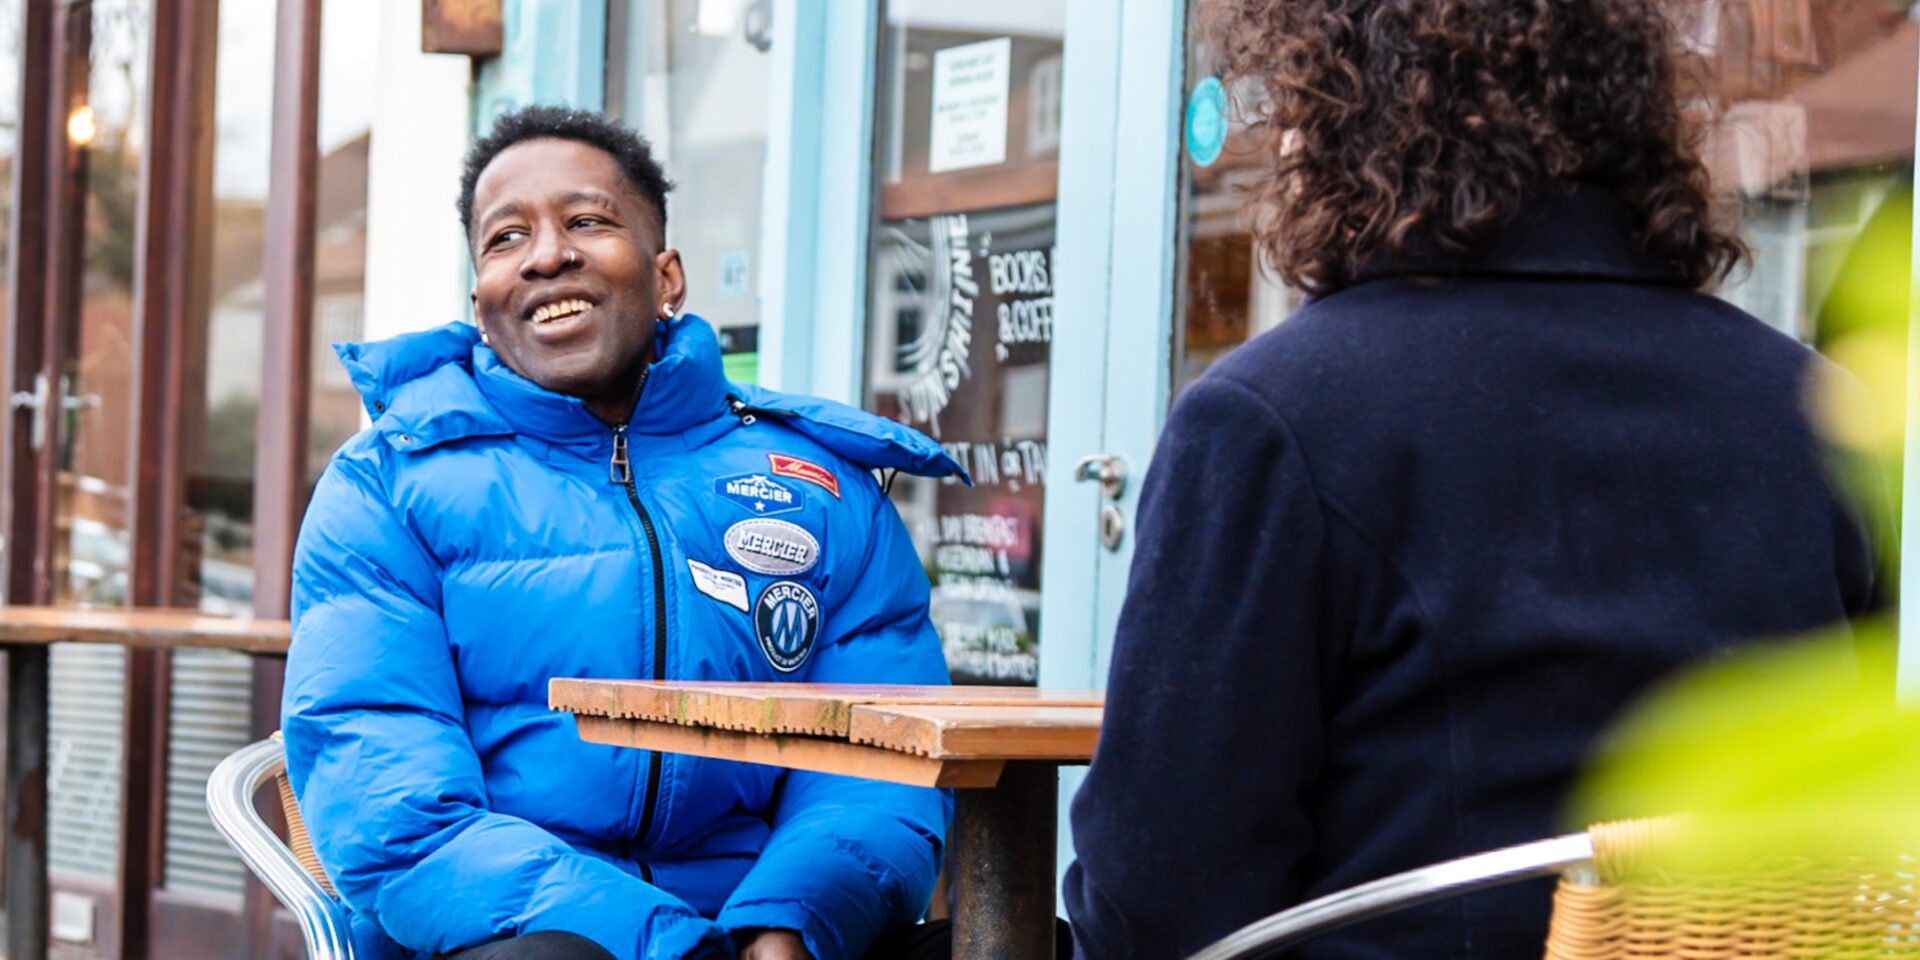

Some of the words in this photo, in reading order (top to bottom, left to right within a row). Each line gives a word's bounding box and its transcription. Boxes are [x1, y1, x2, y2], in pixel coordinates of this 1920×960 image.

[973, 443, 1000, 485] IN
[726, 482, 793, 503] MERCIER
[737, 529, 809, 566] MERCIER
[764, 585, 815, 619] MERCIER
[773, 602, 803, 652] M
